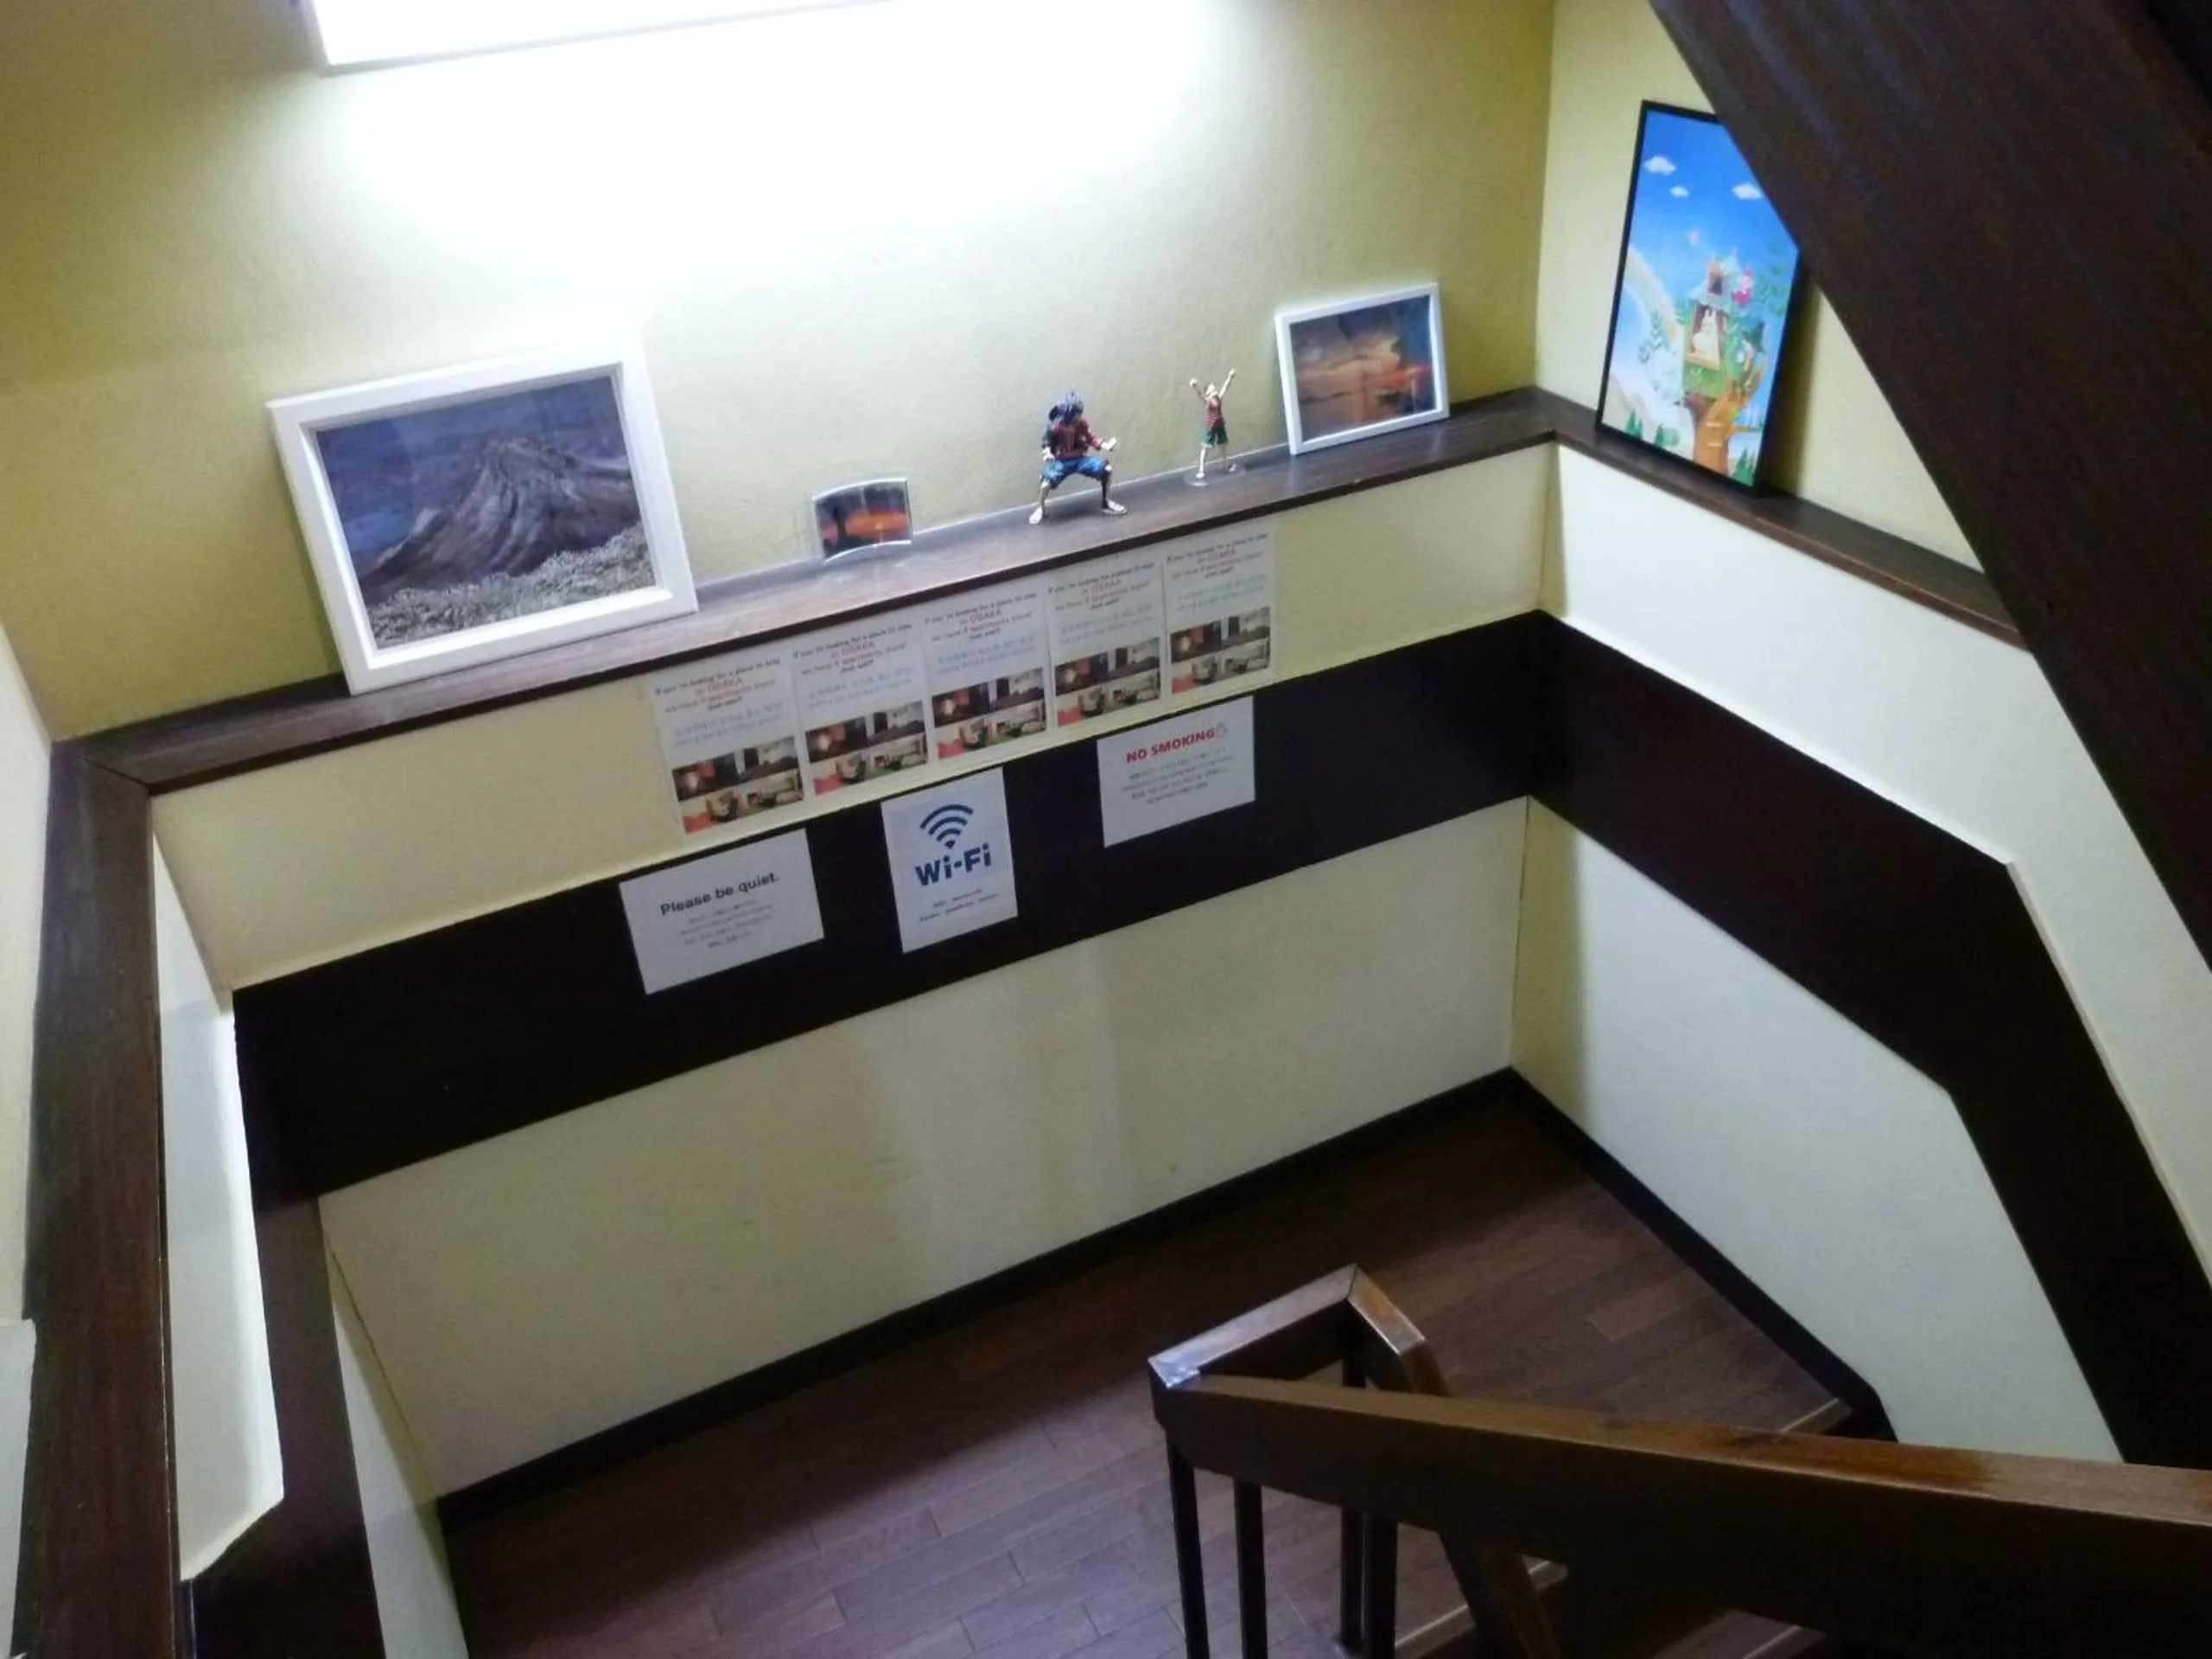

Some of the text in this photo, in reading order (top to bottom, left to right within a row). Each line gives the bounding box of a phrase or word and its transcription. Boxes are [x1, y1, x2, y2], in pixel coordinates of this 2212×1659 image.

[1126, 748, 1147, 763] NO
[1150, 727, 1216, 756] SMOKING
[915, 842, 991, 887] Wi-Fi
[660, 893, 711, 916] Please
[715, 887, 734, 899] be
[738, 873, 779, 893] quiet.
